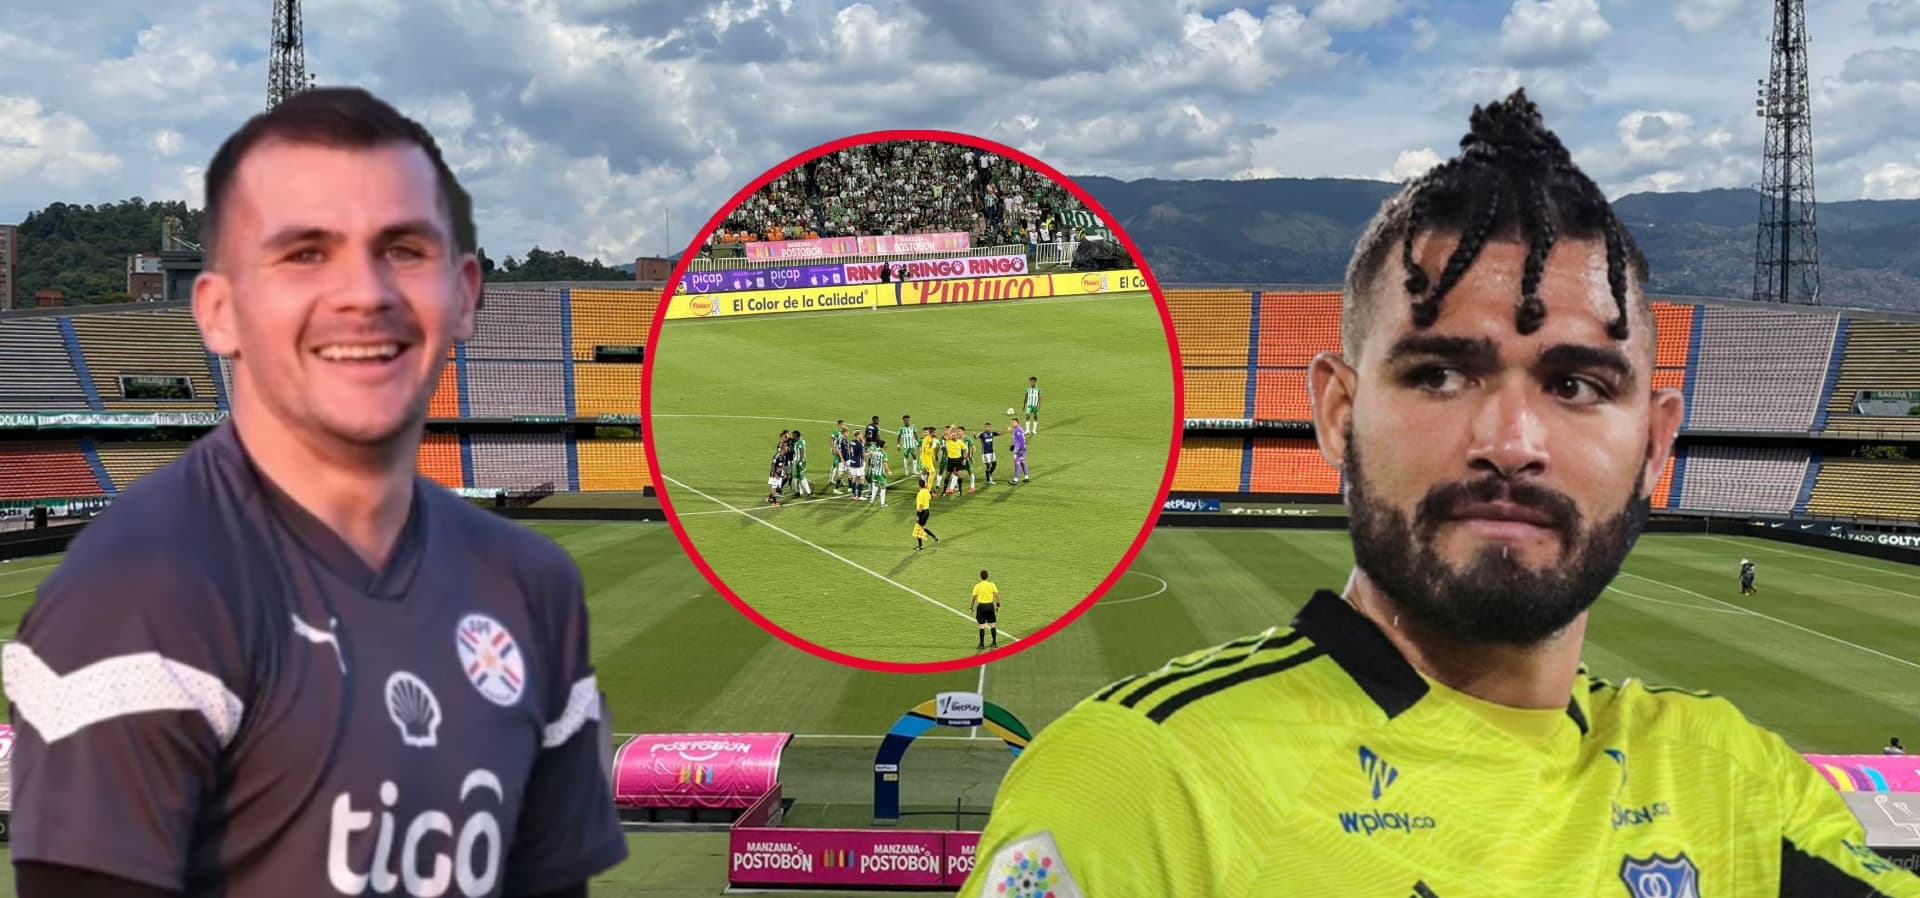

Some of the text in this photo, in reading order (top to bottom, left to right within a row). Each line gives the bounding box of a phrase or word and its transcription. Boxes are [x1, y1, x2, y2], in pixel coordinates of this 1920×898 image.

[907, 261, 965, 279] RINGO
[968, 257, 1025, 275] RINGO
[692, 273, 724, 287] picap
[770, 268, 801, 283] picap
[1119, 276, 1129, 288] El
[912, 274, 1036, 305] Pintuco
[733, 290, 865, 312] El Color de la Calidad
[1163, 500, 1197, 511] etPlay
[1878, 534, 1920, 547] GOLTY
[746, 842, 793, 852] MANZANA
[873, 844, 920, 855] MANZANA
